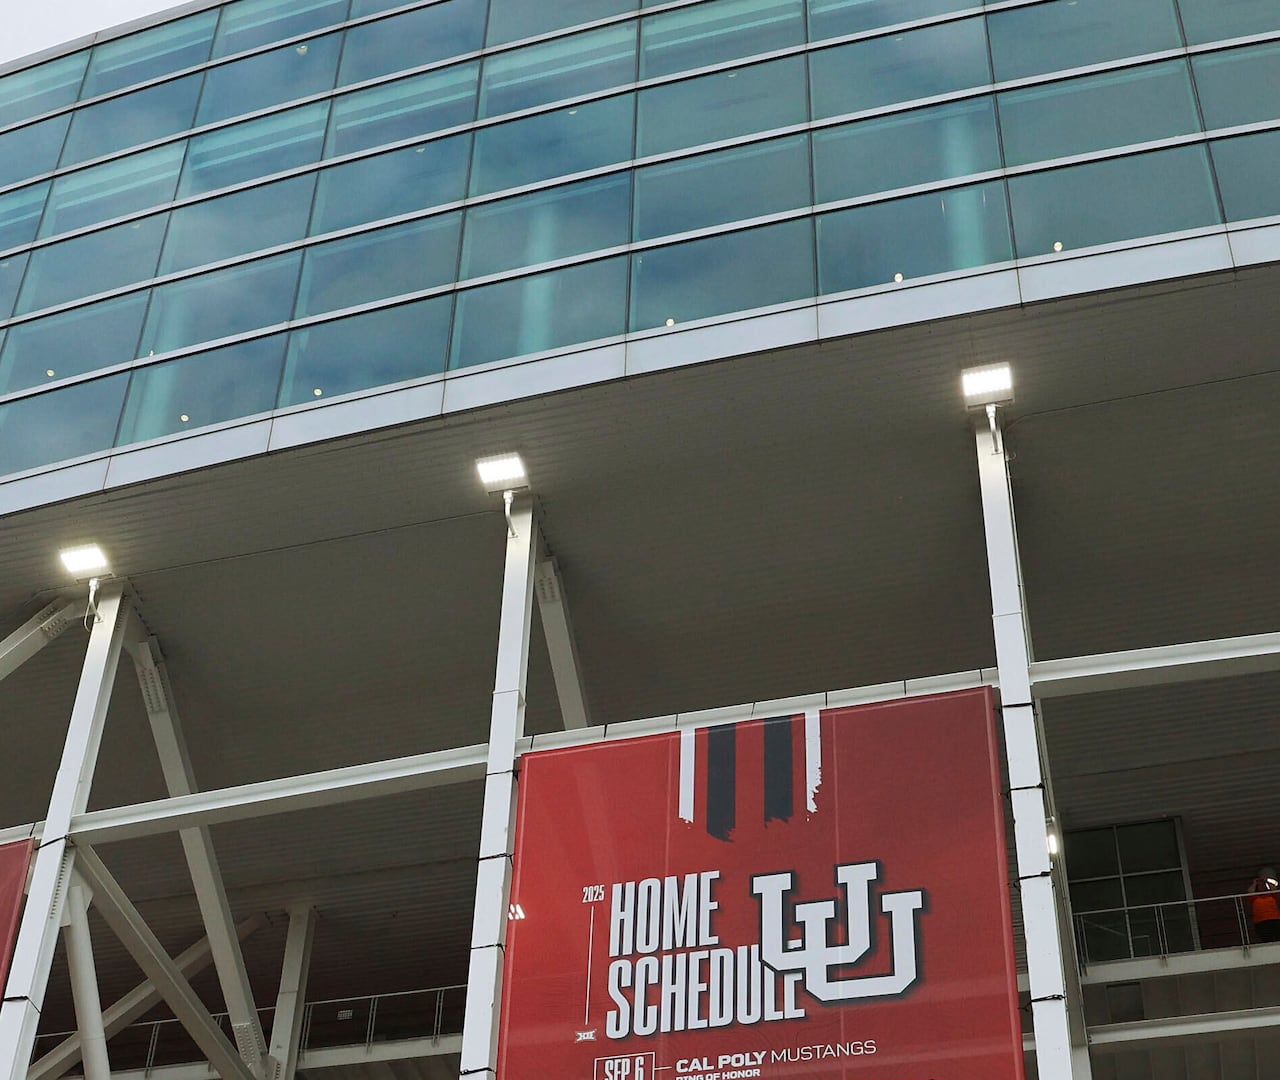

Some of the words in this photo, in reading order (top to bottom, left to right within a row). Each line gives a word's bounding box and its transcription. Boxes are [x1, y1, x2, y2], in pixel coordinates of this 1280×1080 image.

[582, 884, 605, 903] 2025
[608, 870, 721, 958] HOME
[605, 943, 806, 1040] SCHEDULE
[676, 1057, 716, 1074] CAL
[718, 1050, 767, 1070] POLY
[771, 1039, 877, 1064] MUSTANGS
[721, 1067, 761, 1080] HONOR
